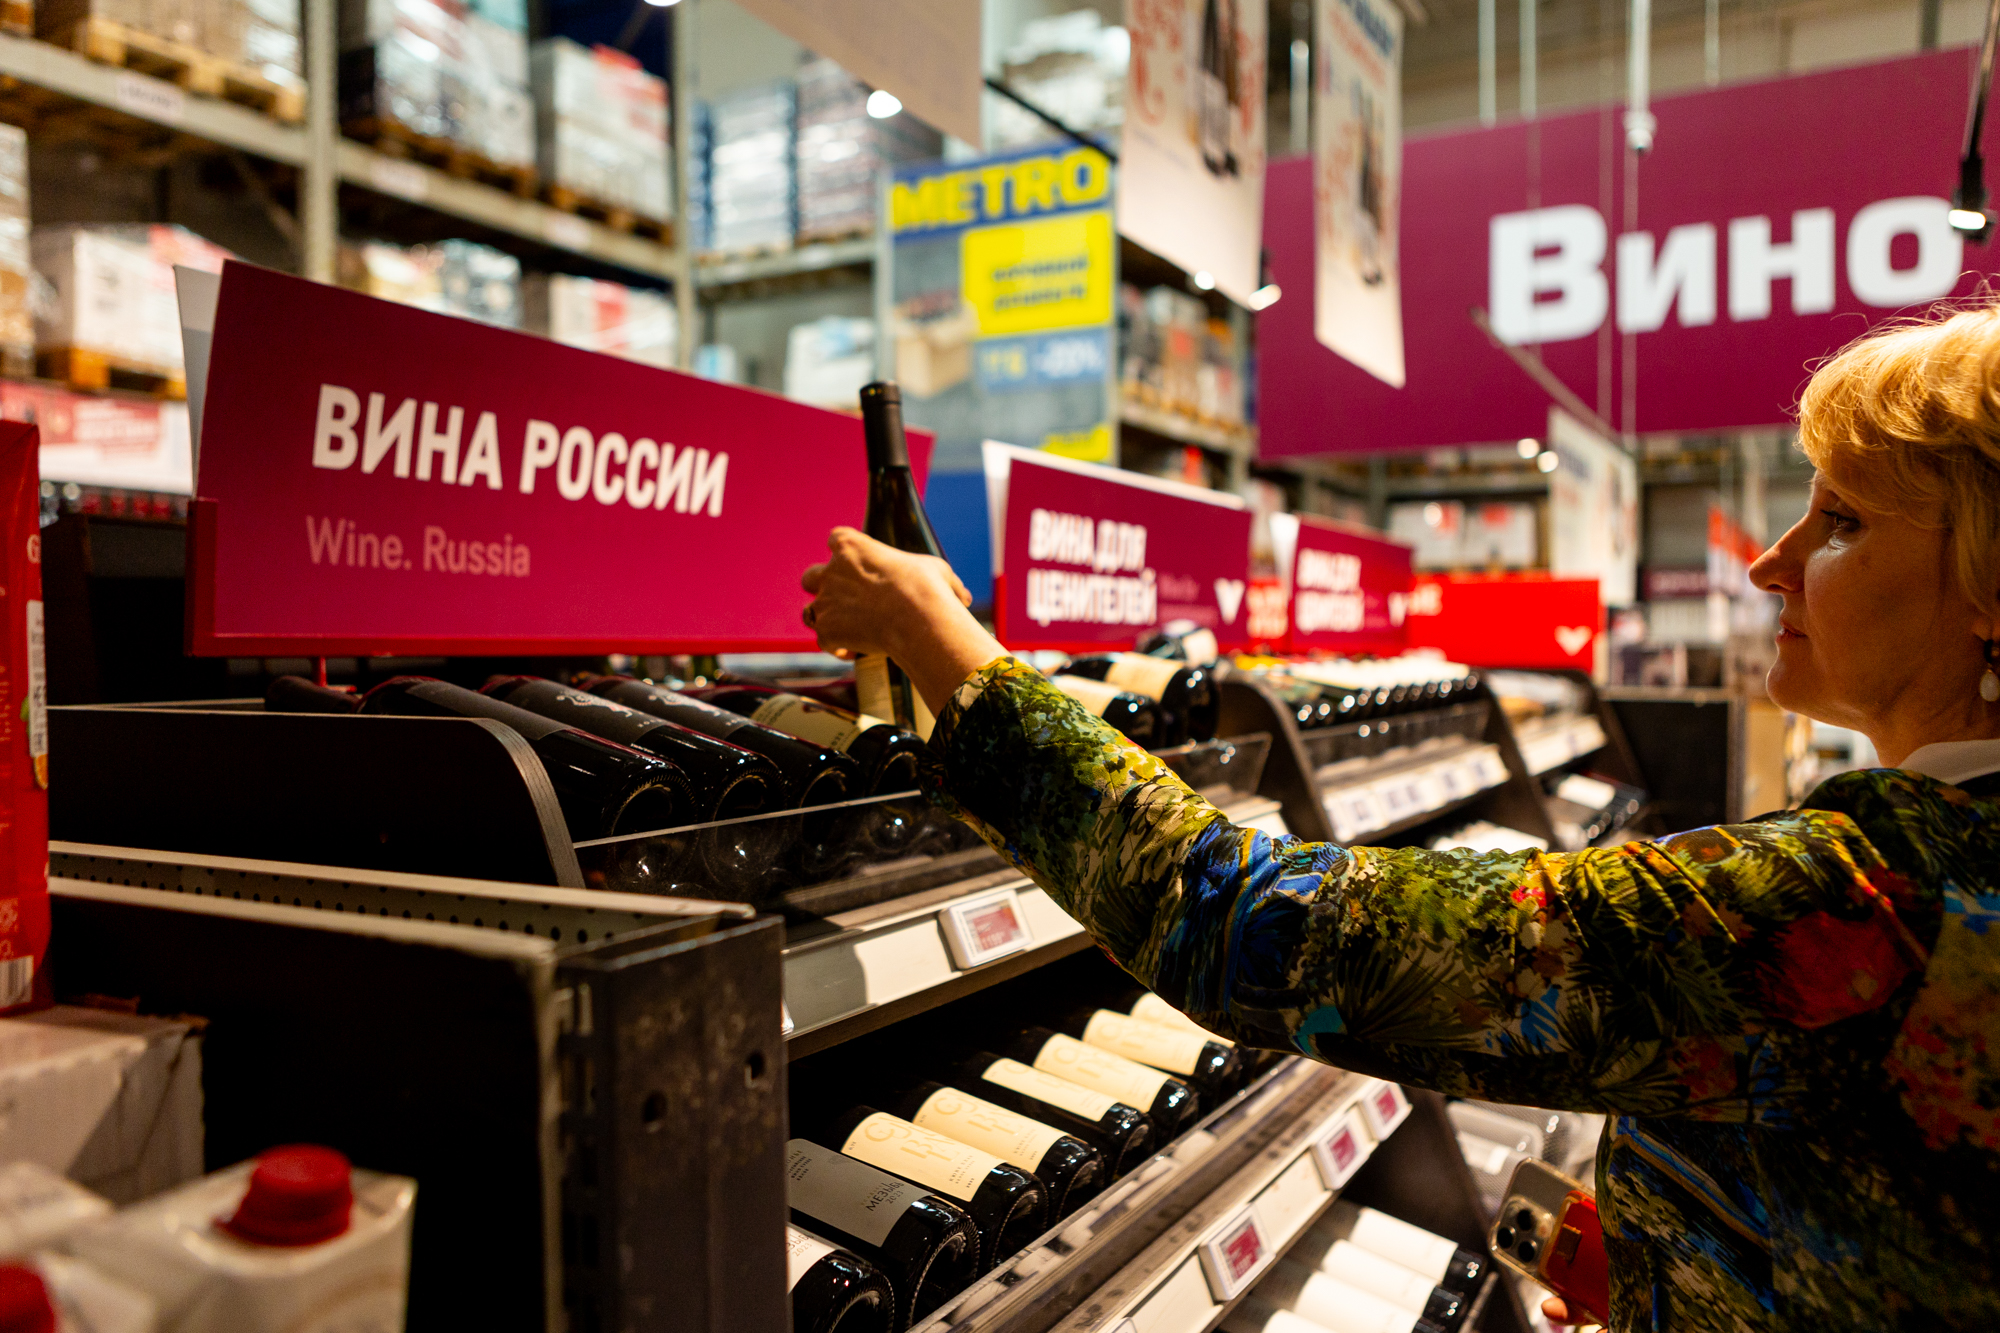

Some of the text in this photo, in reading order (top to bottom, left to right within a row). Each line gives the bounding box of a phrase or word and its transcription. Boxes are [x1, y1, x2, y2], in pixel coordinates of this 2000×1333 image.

[891, 147, 1108, 231] METRO
[1488, 195, 1964, 346] Вино
[311, 383, 729, 518] ВИНА РОССИИ
[306, 515, 531, 578] Wine. Russia
[1028, 508, 1147, 574] ВИНА ДЛЯ
[1026, 567, 1158, 627] ЦЕНИТЕЛЕЙ
